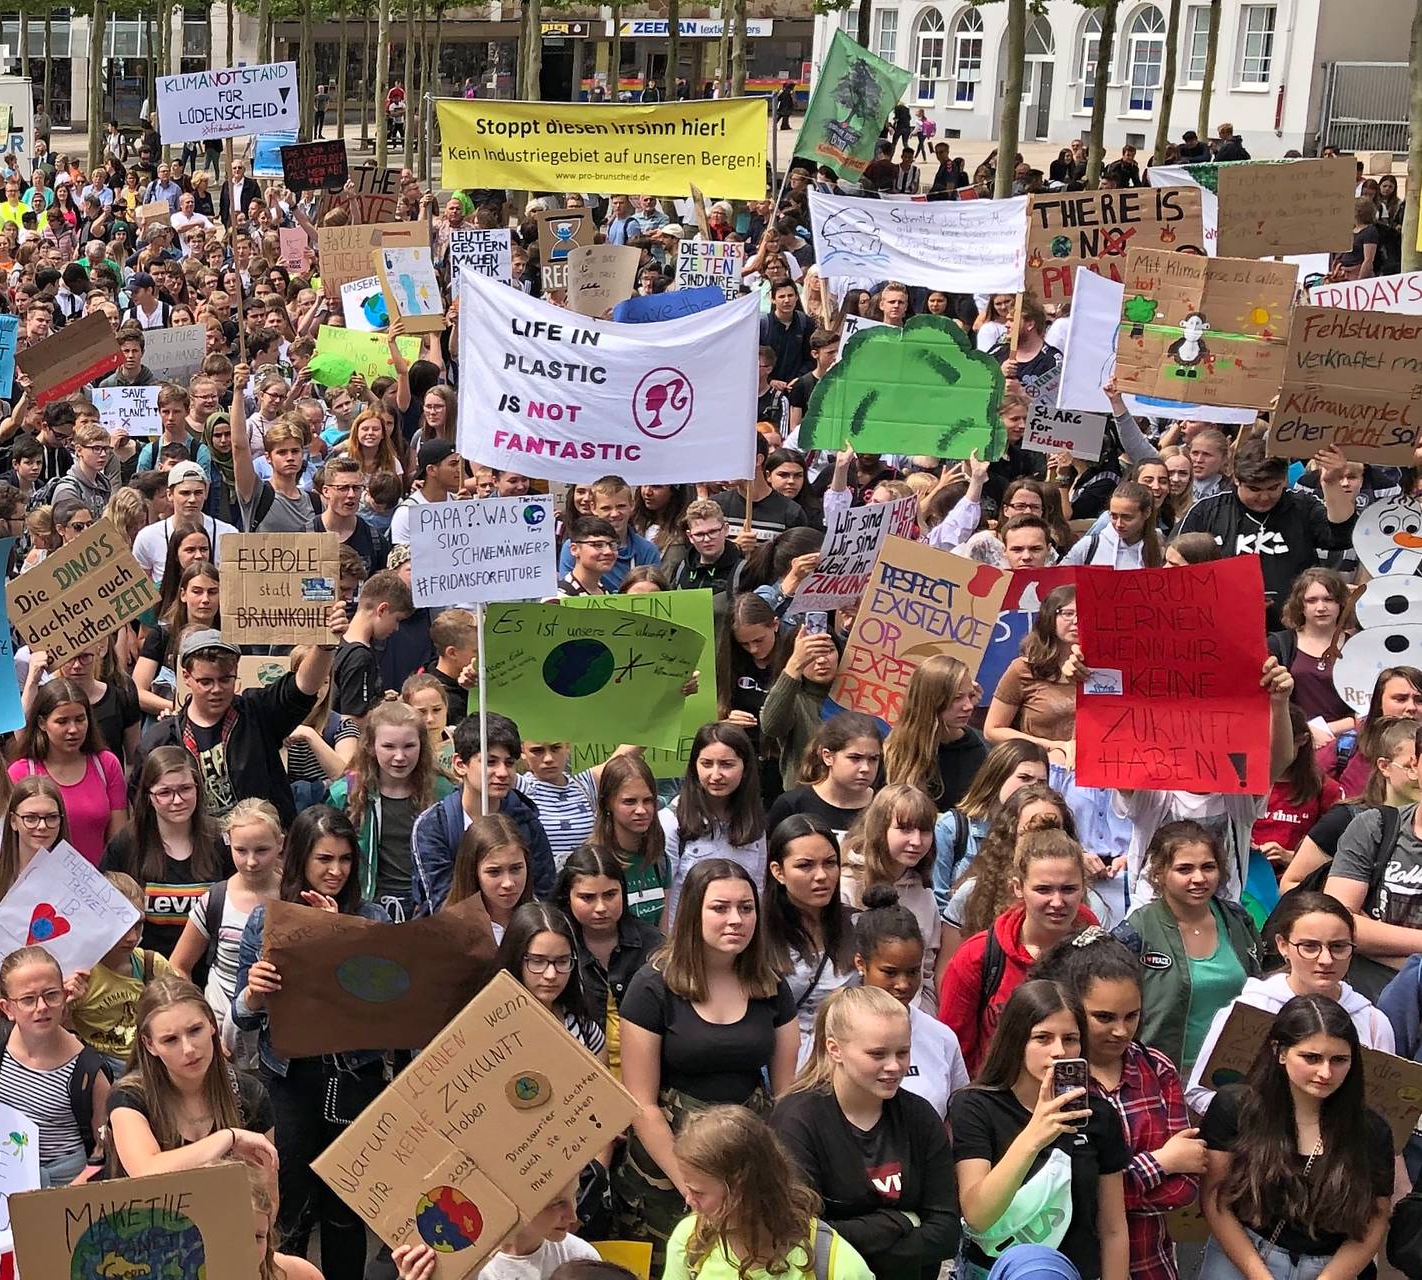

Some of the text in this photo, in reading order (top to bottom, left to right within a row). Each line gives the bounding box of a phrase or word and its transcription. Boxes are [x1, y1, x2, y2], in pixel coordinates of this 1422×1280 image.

[164, 64, 289, 93] KLIMANOTSTAND
[218, 88, 244, 103] FÜR
[449, 146, 762, 172] Kein Industriegebiet auf unseren Bergen!
[353, 167, 402, 195] THE
[1032, 191, 1141, 229] THERE
[1155, 187, 1184, 222] IS
[451, 230, 491, 243] LEUTE
[451, 240, 508, 253] GESTERN
[511, 317, 601, 347] LIFE IN
[504, 354, 607, 385] PLASTIC
[122, 388, 146, 399] SAVE
[134, 399, 150, 409] THE
[498, 393, 582, 422] IS NOT
[1283, 392, 1409, 427] Klimawandel
[1029, 418, 1053, 434] for
[1029, 431, 1075, 450] Future
[493, 431, 642, 462] FANTASTIC
[483, 505, 519, 526] WAS
[835, 505, 883, 536] Wir sind
[437, 532, 470, 550] SIND
[828, 531, 878, 559] Wir sind
[237, 546, 318, 573] EISPOLE
[13, 534, 117, 615] Die DINO'S
[416, 565, 543, 597] #FRIDAYSFORFUTURE
[878, 560, 961, 609] RESPECT
[1087, 568, 1220, 603] WARUM
[259, 582, 291, 597] statt
[27, 566, 134, 645] dachten auch
[237, 606, 333, 629] BRAUNKOHLE
[870, 588, 992, 651] EXISTENCE
[1093, 605, 1216, 633] LERNEN
[492, 609, 524, 635] Es
[537, 609, 561, 637] ist
[858, 616, 902, 659] OR
[1095, 635, 1223, 664] WENN WIR
[1127, 664, 1216, 699] KEINE
[1100, 703, 1246, 745] ZUKUNFT
[335, 992, 529, 1195] Warum LERNEN wenn
[357, 1028, 526, 1221] WIR KEINE ZUKUNFT
[64, 1191, 194, 1254] MAKE THE
